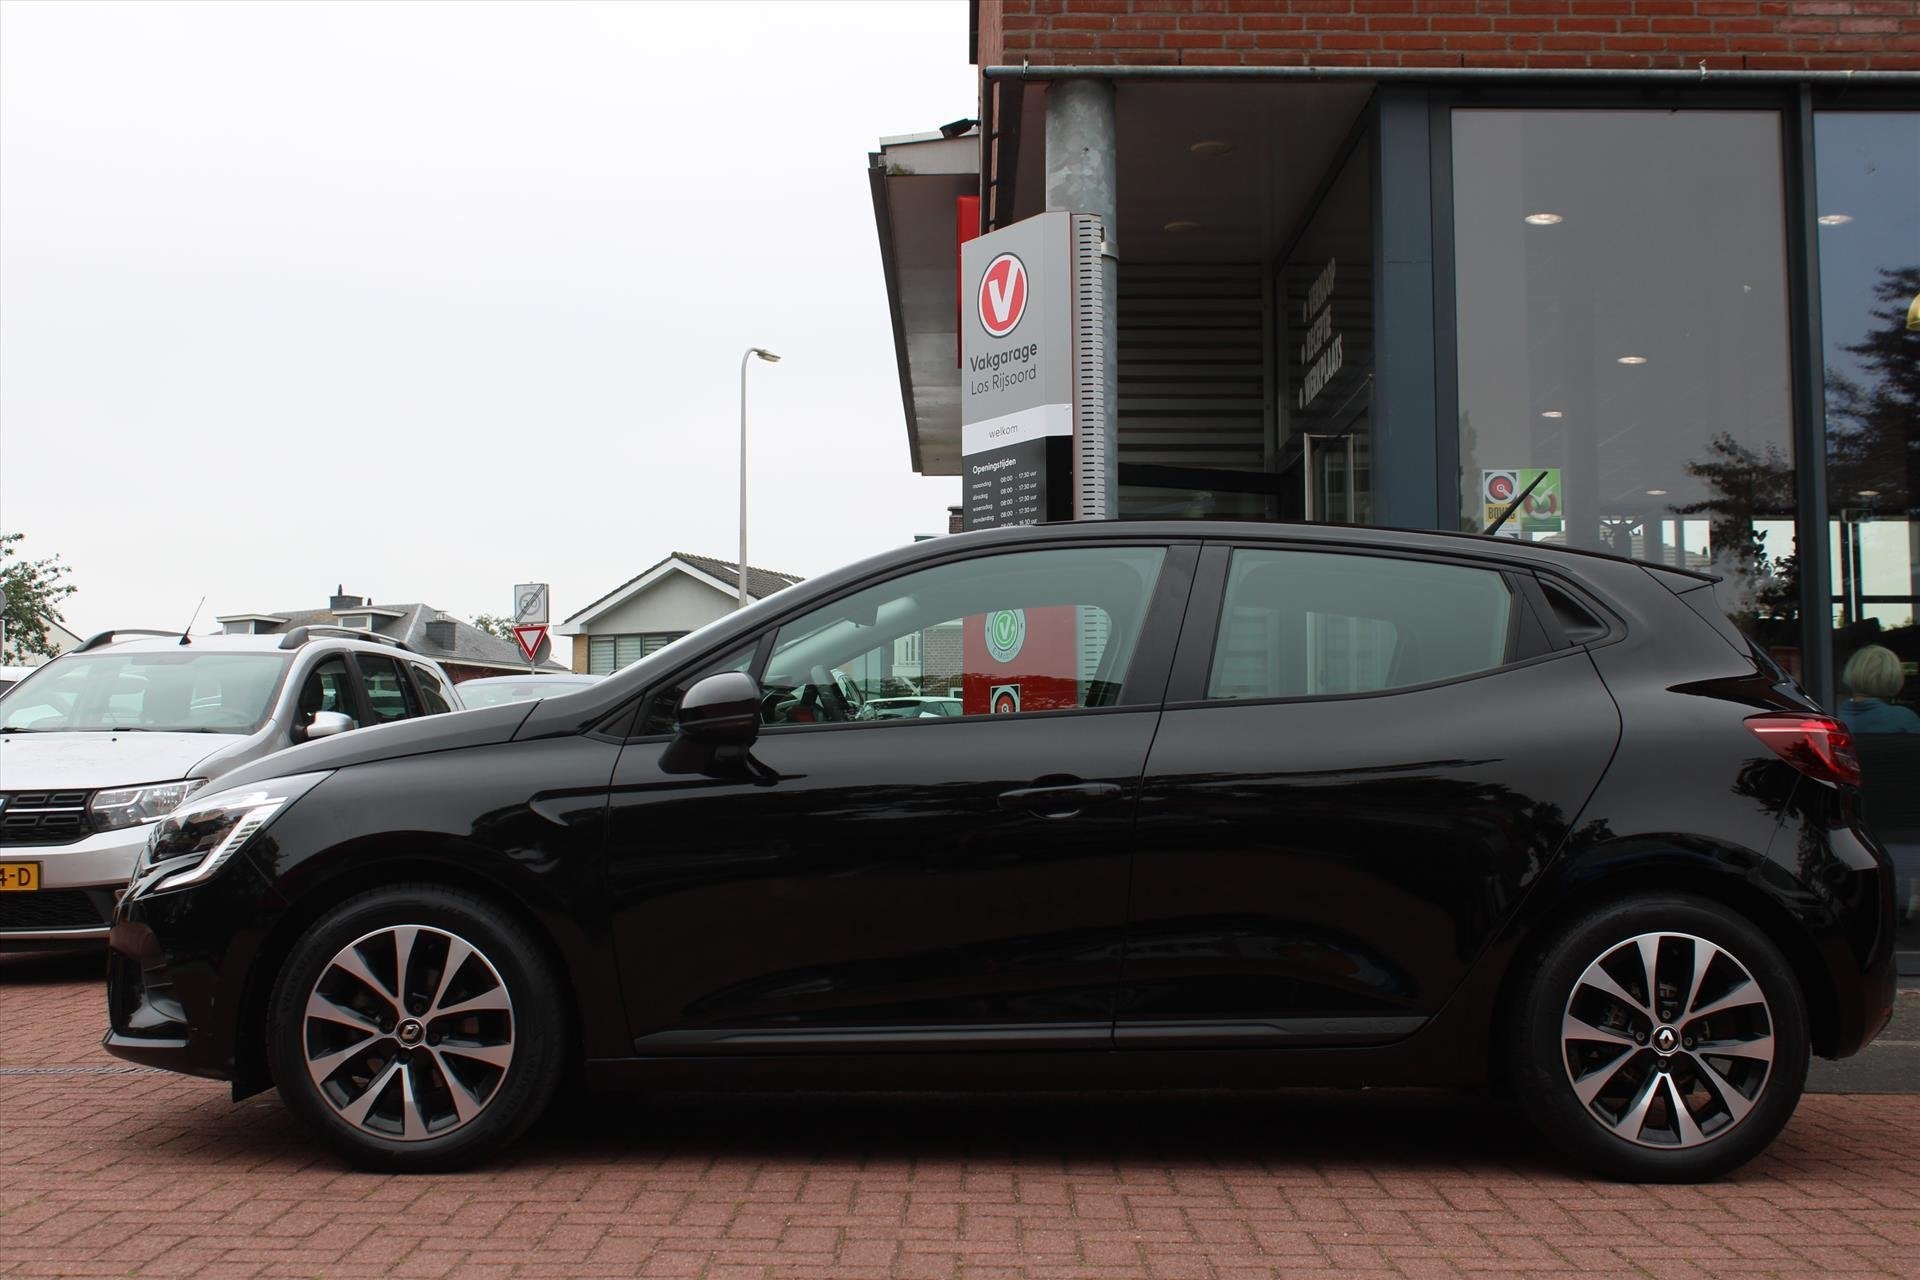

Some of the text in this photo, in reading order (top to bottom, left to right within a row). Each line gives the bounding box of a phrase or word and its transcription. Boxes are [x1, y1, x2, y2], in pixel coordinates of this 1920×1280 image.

[970, 343, 1038, 373] Vakgarage
[1304, 332, 1343, 406] WERKPLAATS
[971, 363, 1037, 395] Los Rijsoord
[989, 424, 1018, 438] welkom
[973, 458, 1017, 475] Openingstijden
[972, 481, 992, 489] maandag
